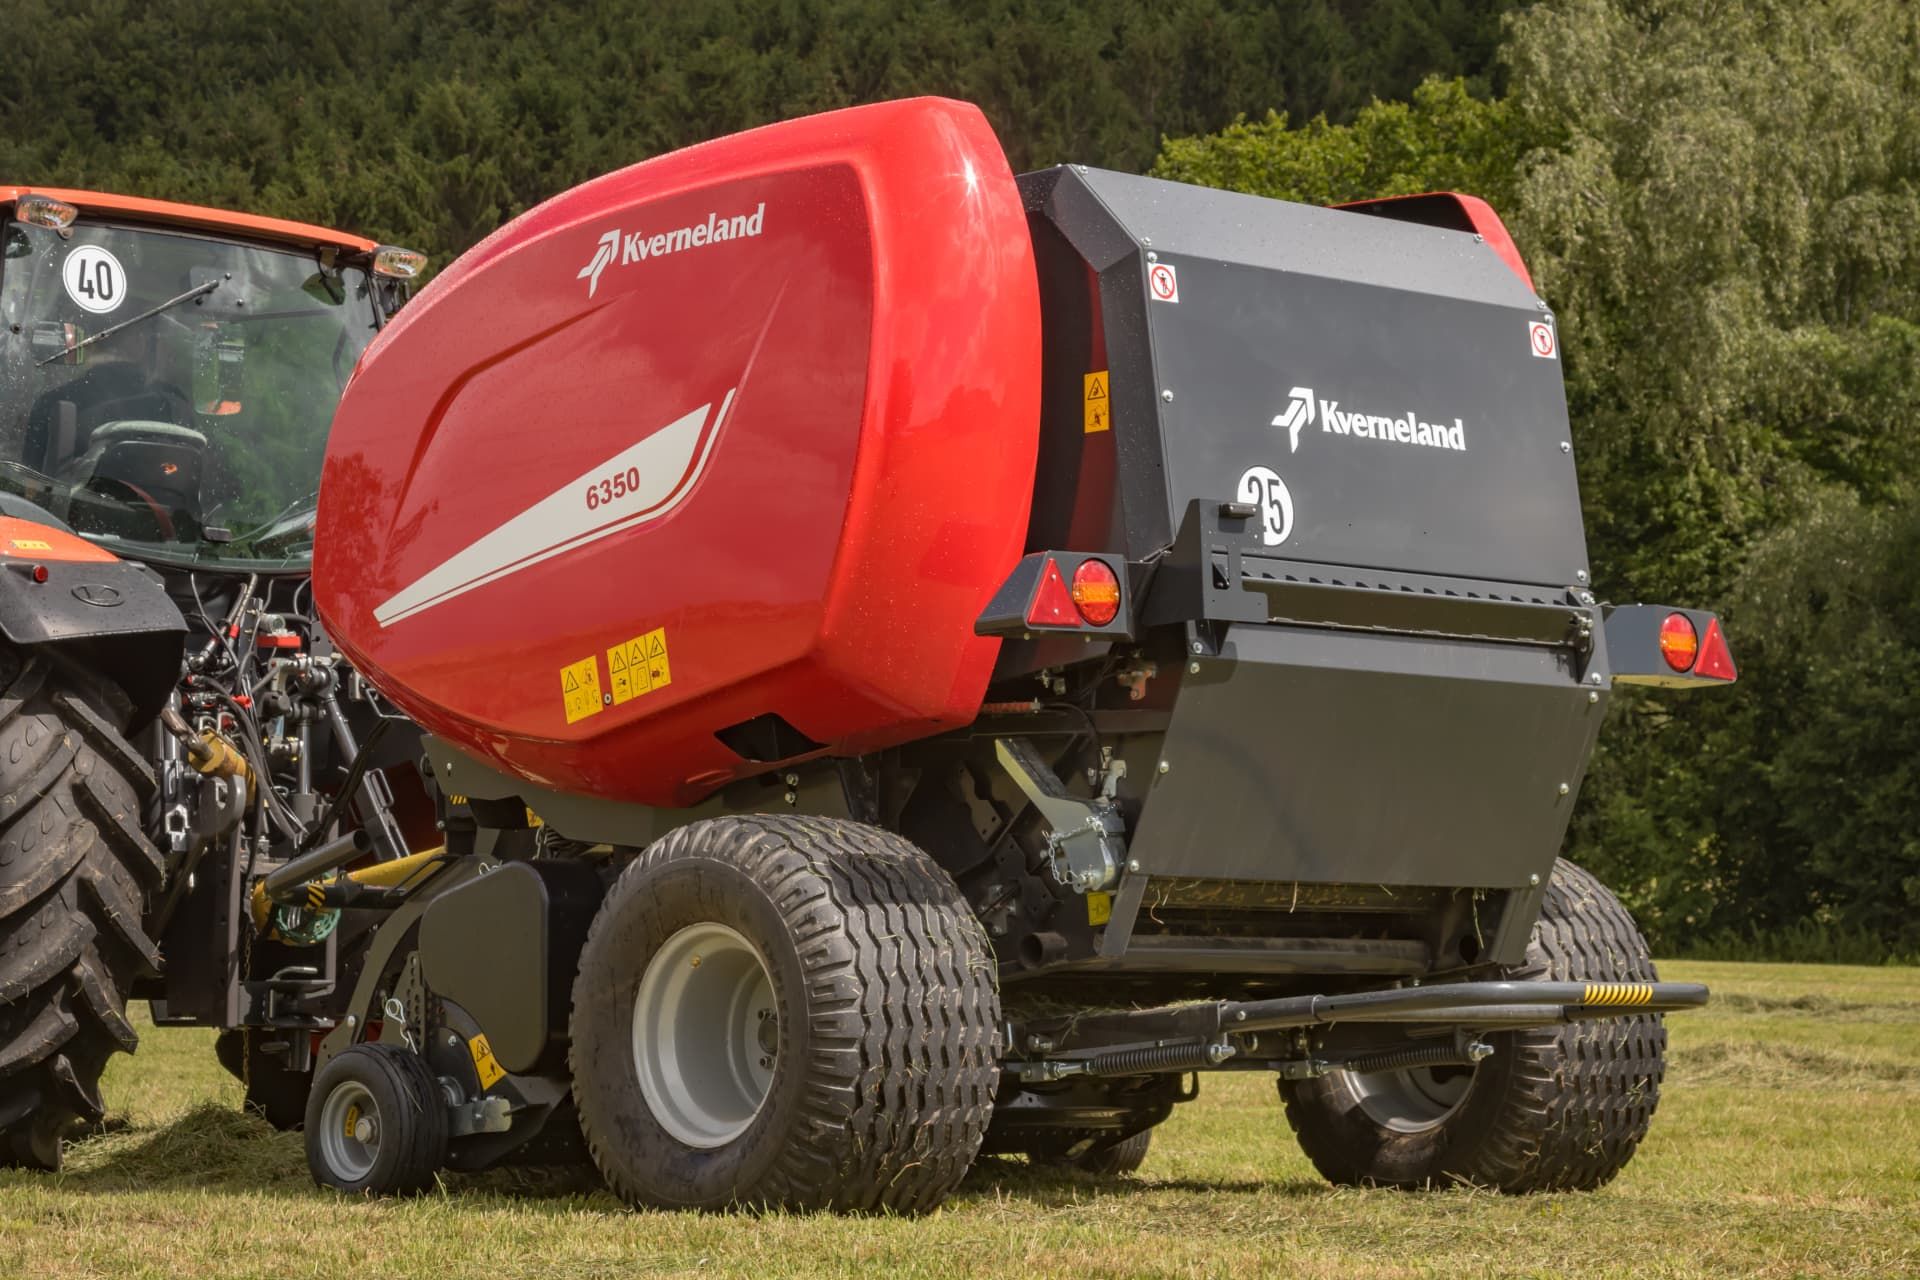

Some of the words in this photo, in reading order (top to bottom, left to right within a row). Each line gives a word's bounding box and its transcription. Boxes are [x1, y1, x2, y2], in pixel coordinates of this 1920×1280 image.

[621, 202, 765, 266] Kverneland
[78, 258, 113, 301] 40
[1319, 399, 1467, 451] Kverneland
[586, 466, 640, 511] 6350
